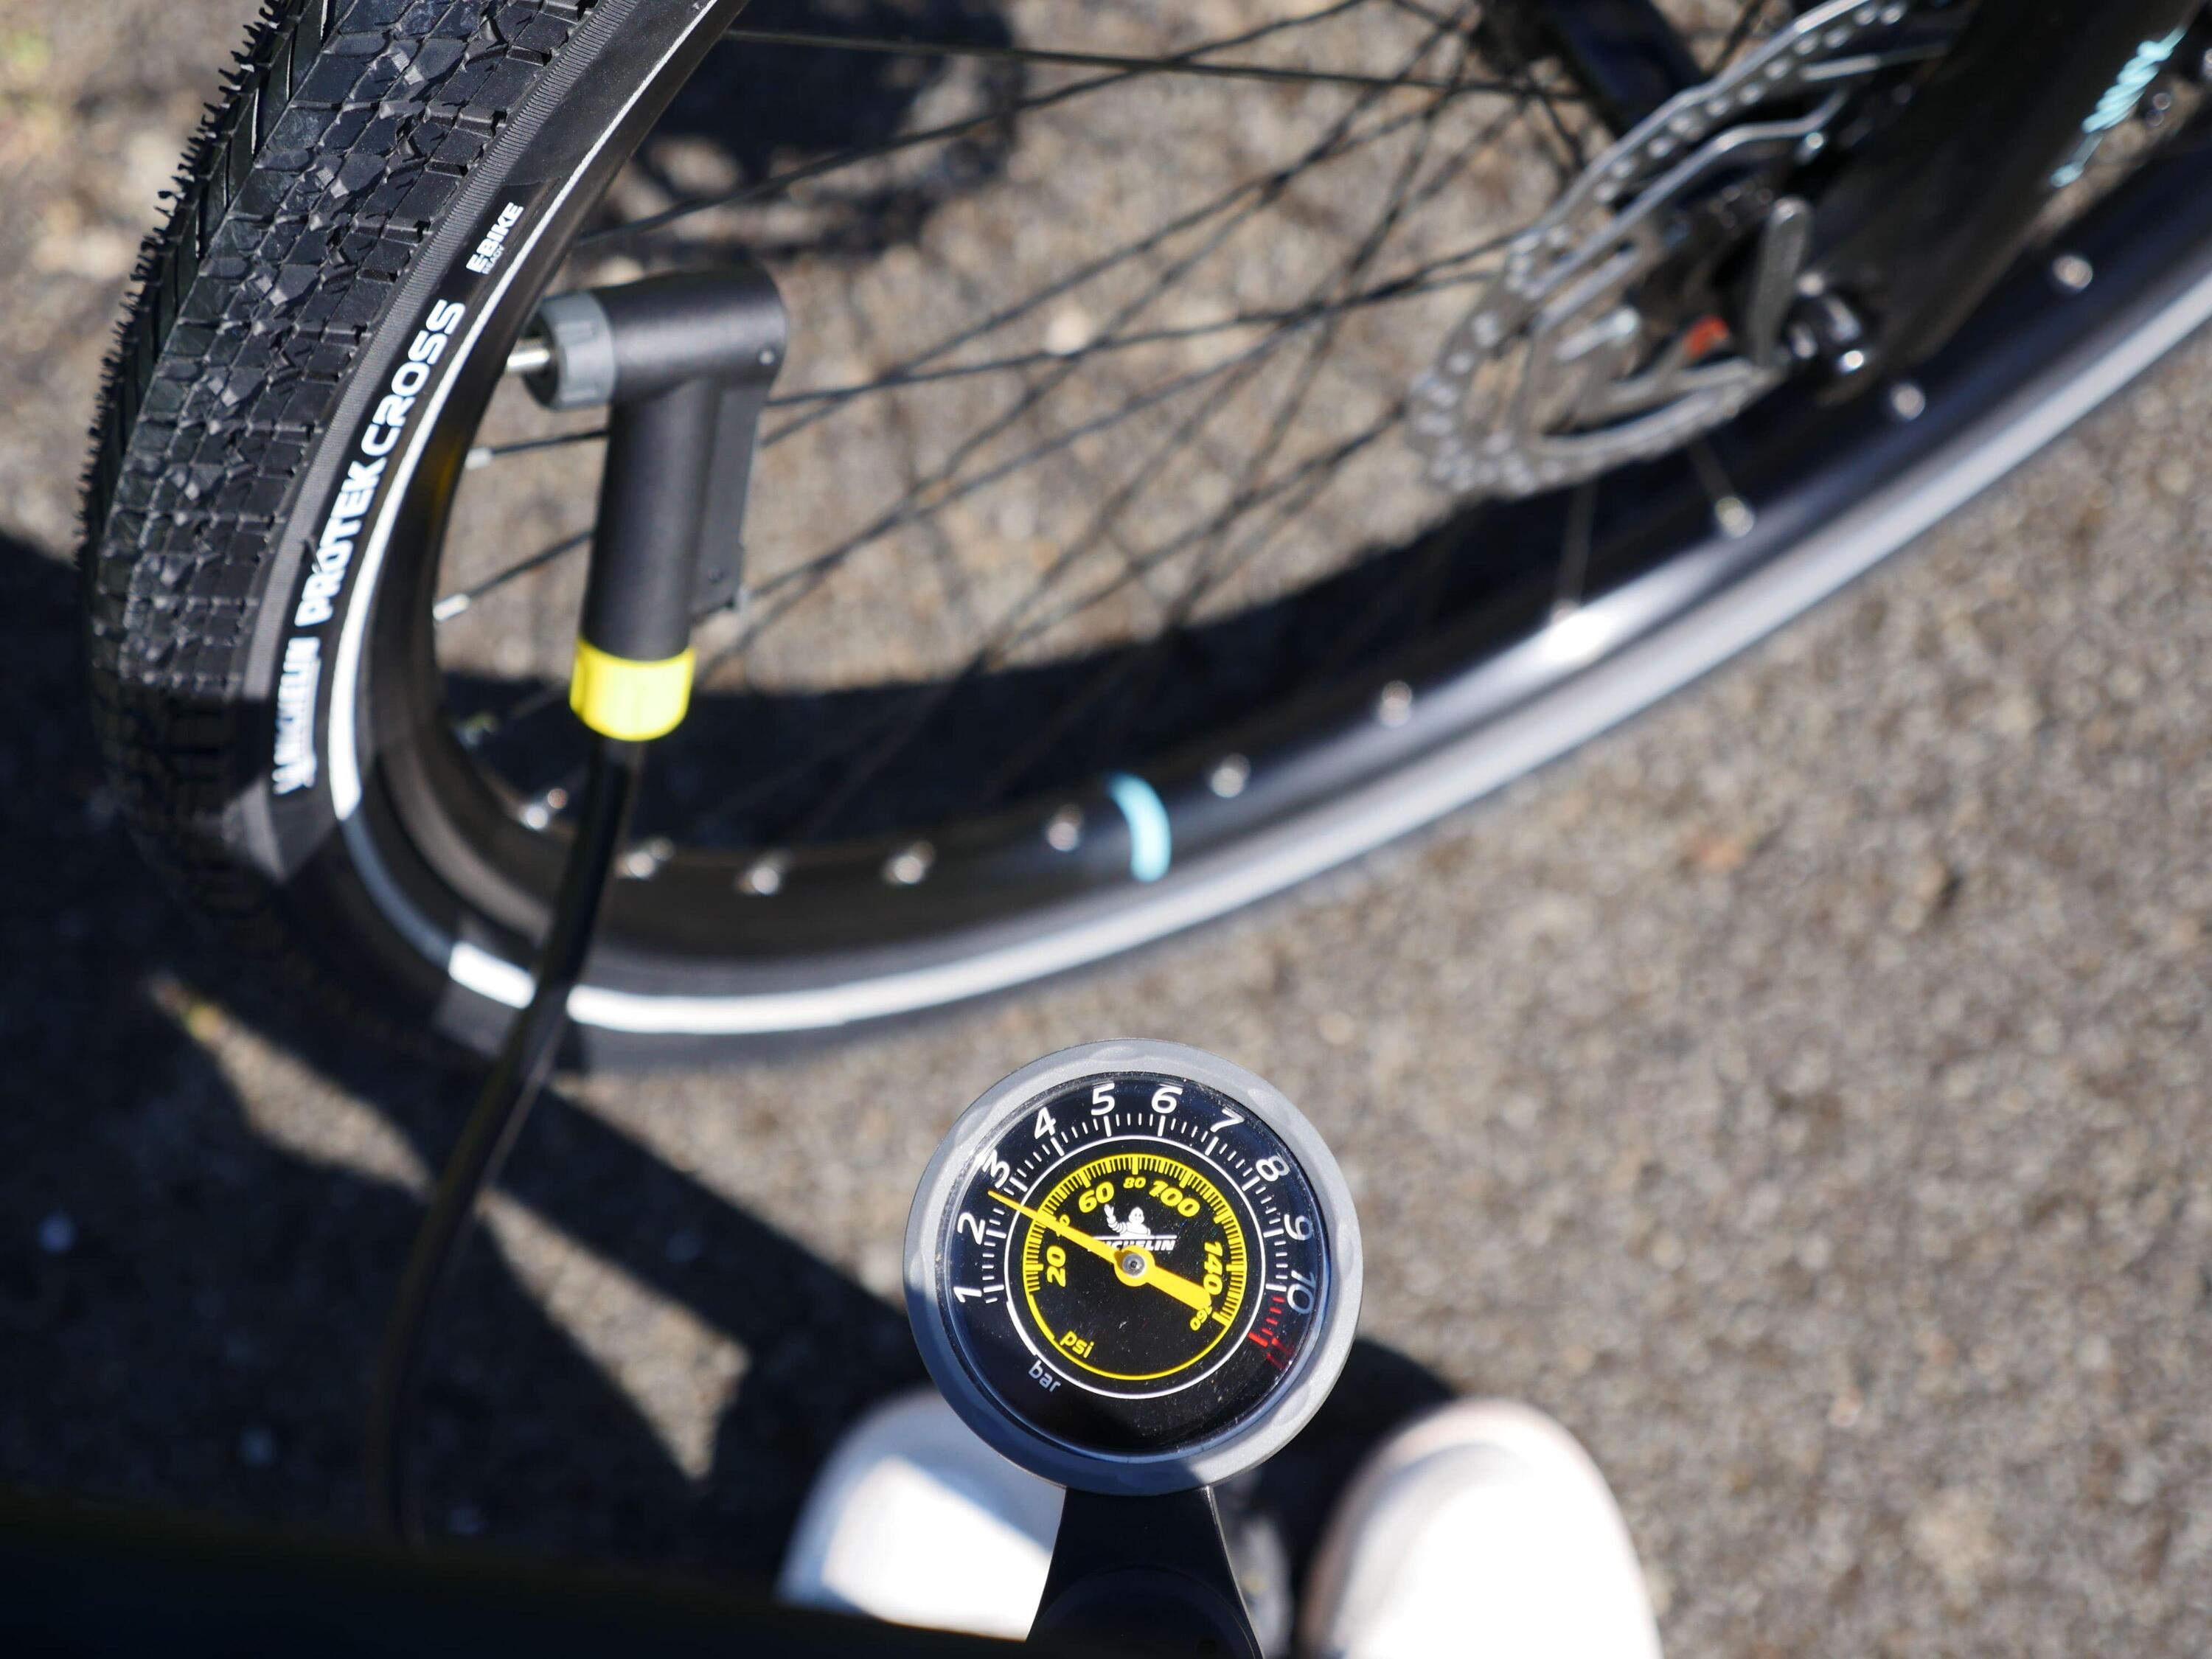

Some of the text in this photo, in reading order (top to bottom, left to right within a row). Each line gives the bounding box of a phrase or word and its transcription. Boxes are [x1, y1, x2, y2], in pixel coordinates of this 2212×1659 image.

[294, 457, 387, 627] PROTEK
[361, 299, 466, 457] CROSS
[1091, 1083, 1115, 1116] 5
[1151, 1085, 1183, 1114] 6
[1034, 1107, 1056, 1139] 4
[1210, 1107, 1245, 1133] 7
[981, 1149, 1010, 1189] 3
[1123, 1177, 1147, 1189] 80
[1256, 1155, 1290, 1181] 8
[1078, 1181, 1114, 1213] 60
[1149, 1180, 1200, 1217] 100
[957, 1211, 985, 1245] 2
[1284, 1214, 1313, 1240] 9
[1046, 1245, 1066, 1287] 20
[1203, 1242, 1222, 1295] 140
[953, 1286, 982, 1303] 1
[1287, 1270, 1316, 1315] 10
[1059, 1330, 1094, 1358] psi
[1028, 1360, 1061, 1392] bar
